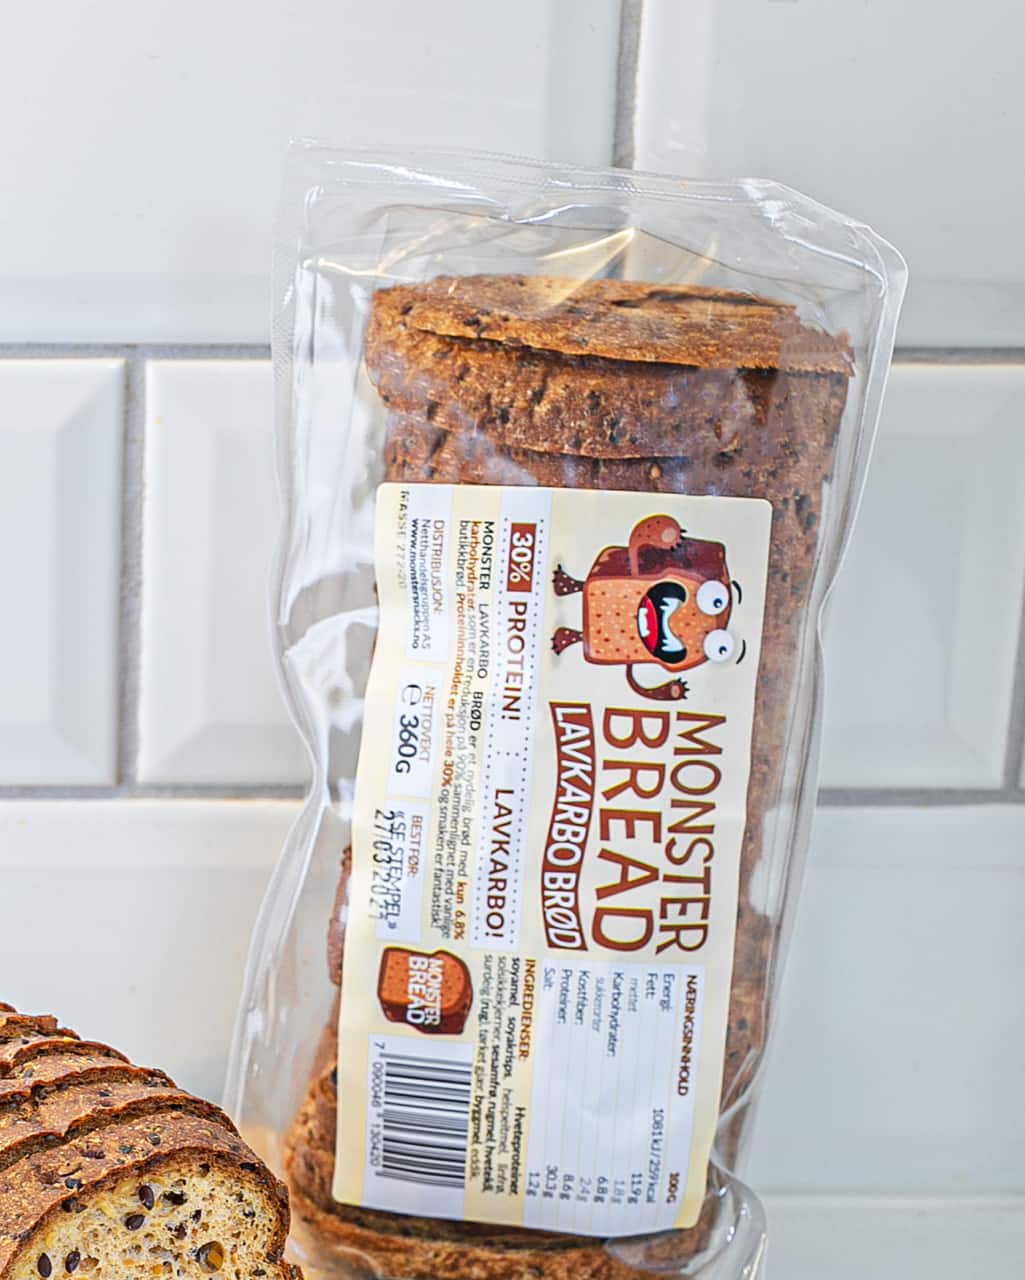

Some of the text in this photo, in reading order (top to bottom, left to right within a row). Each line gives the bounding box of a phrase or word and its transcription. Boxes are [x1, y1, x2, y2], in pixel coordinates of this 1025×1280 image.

[420, 519, 431, 631] Netthandelsgruppen
[432, 519, 444, 614] DISTRIBUSJON:
[479, 521, 494, 589] MONSTER
[450, 592, 465, 695] Proteininnholdet
[476, 603, 488, 678] LAVKARBO
[501, 532, 533, 721] 30% PROTEIN!
[444, 713, 456, 728] på
[454, 674, 472, 733] reduksjon
[469, 691, 482, 730] BRØD
[441, 759, 454, 786] 30%
[444, 731, 456, 756] hele
[454, 736, 466, 750] på
[454, 754, 465, 780] 90%
[437, 789, 449, 803] og
[461, 770, 474, 812] nydelig
[407, 815, 422, 877] BEST FØR:
[436, 805, 448, 852] smaken
[446, 783, 461, 866] sammenlignet
[460, 817, 472, 846] brød
[543, 706, 590, 947] LAVKARBO BRØD
[589, 707, 671, 952] BREAD
[656, 711, 725, 956] MONSTER
[444, 869, 456, 895] med
[485, 788, 513, 937] LAVKARBO!
[430, 867, 444, 928] fantastisk!
[438, 897, 454, 937] vanlige
[456, 881, 467, 904] kun
[406, 956, 428, 1023] BREAD
[424, 958, 443, 1025] MONSTER
[479, 954, 493, 996] surdeig
[557, 968, 572, 1024] Proteiner:
[575, 969, 589, 1025] Kostfiber:
[645, 972, 658, 999] Fett:
[518, 958, 535, 1062] INGREDIENSER:
[607, 972, 623, 1056] Karbohydrater:
[677, 974, 696, 1096] NÆRINGSINNHOLD
[477, 1029, 488, 1064] tørket
